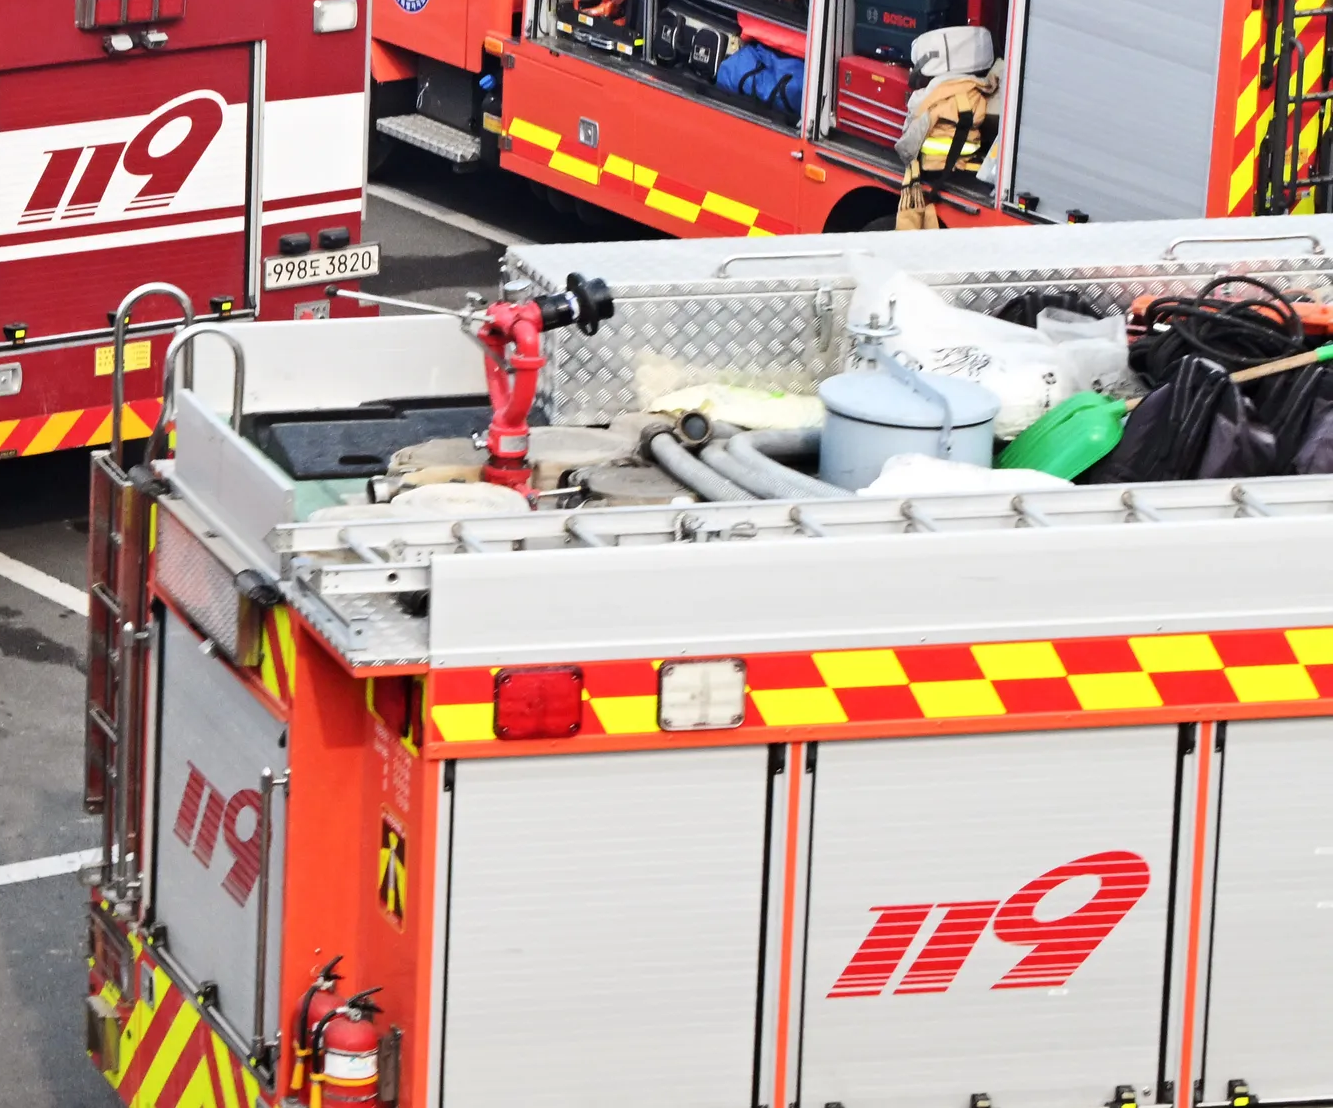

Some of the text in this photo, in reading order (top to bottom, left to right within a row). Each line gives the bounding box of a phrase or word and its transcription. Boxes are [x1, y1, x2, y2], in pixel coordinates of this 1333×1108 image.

[883, 11, 917, 29] BOSCH
[17, 94, 224, 226] 119
[273, 250, 372, 283] 998도 3820
[172, 759, 273, 908] 119
[826, 850, 1151, 999] 119
